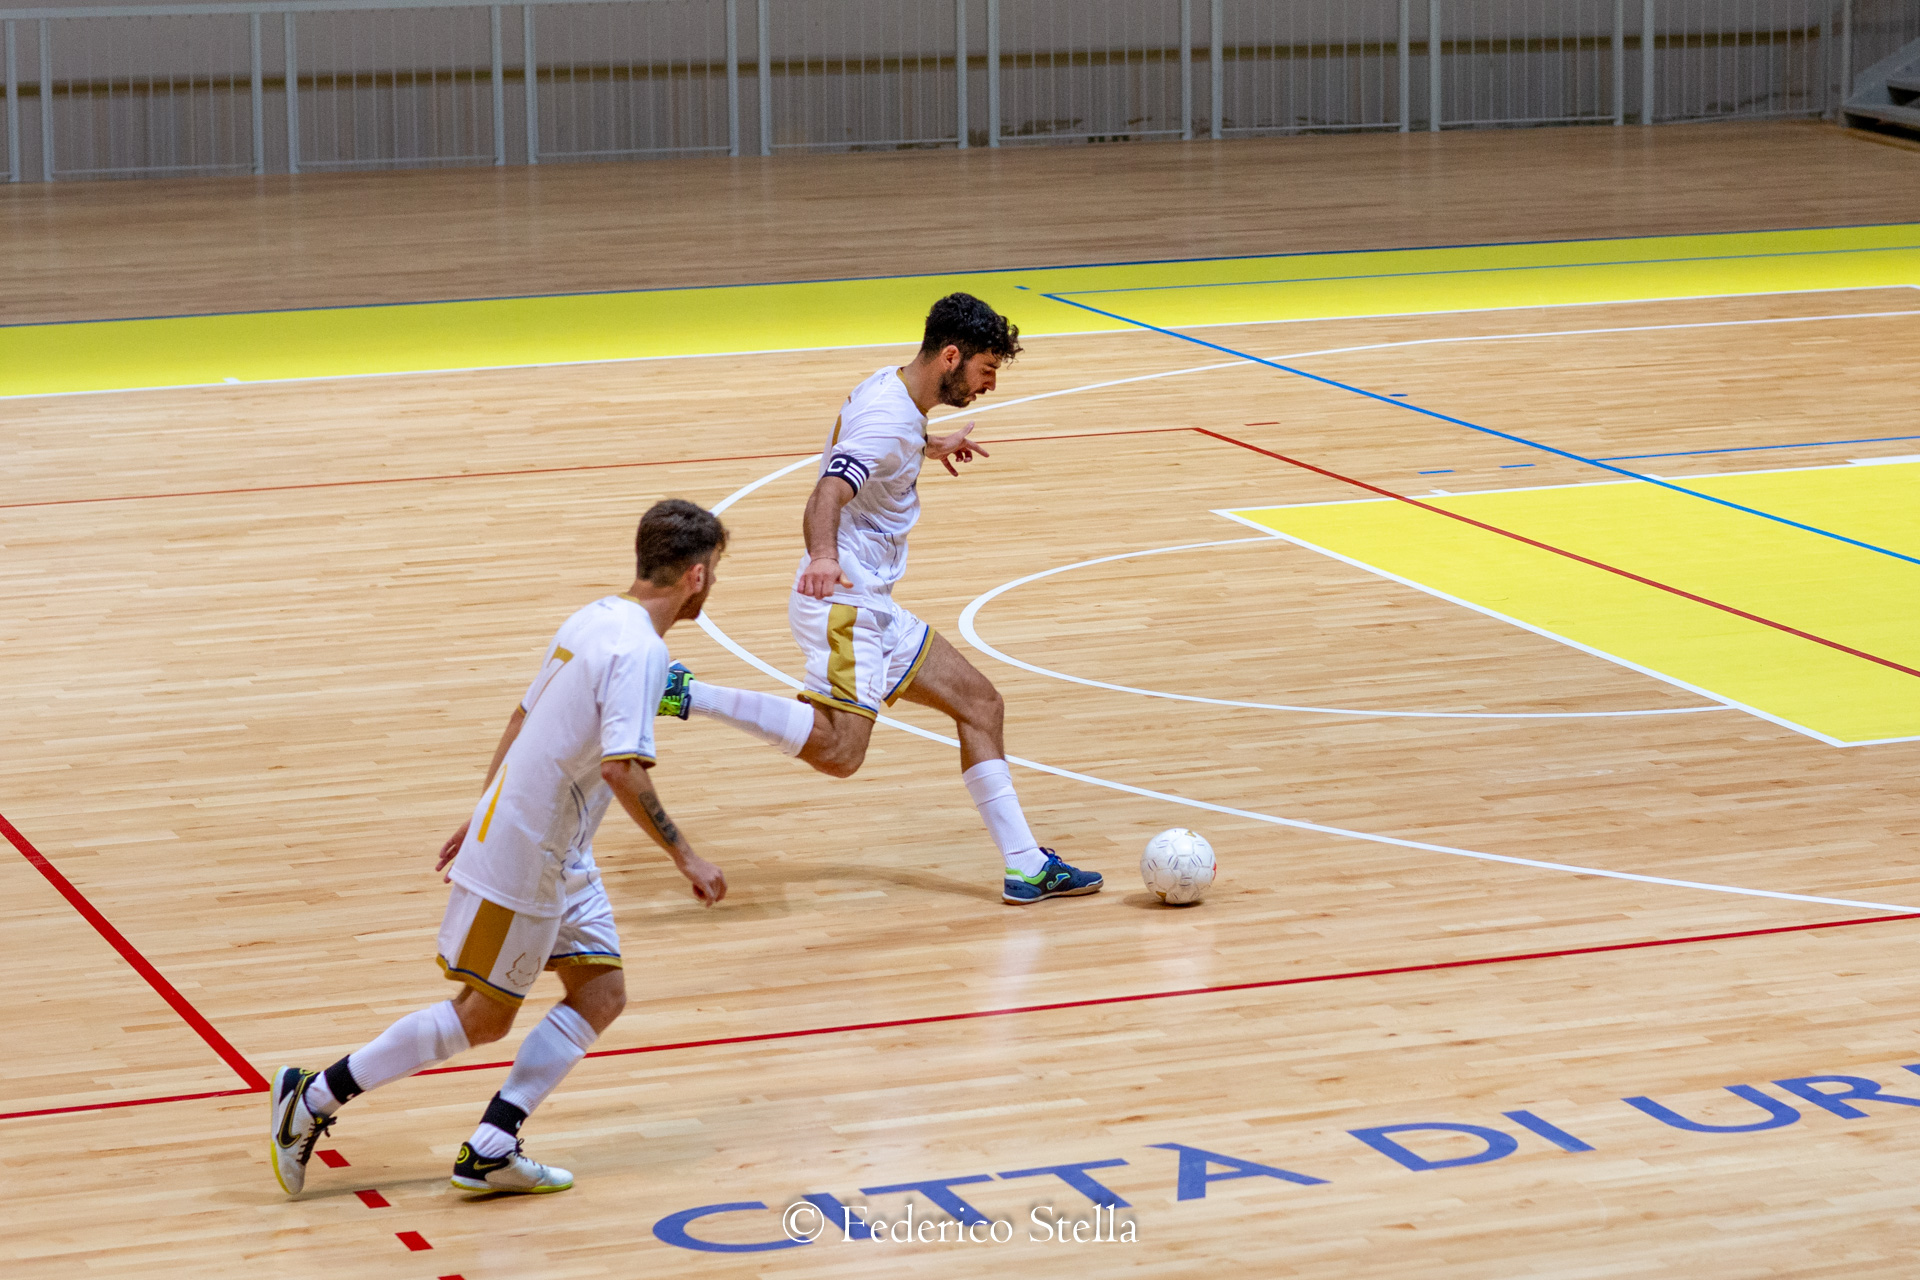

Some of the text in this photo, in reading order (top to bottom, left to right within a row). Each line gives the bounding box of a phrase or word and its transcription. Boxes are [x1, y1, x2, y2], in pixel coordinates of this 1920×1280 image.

[827, 457, 848, 473] C
[652, 1063, 1920, 1254] CITTA DI UR
